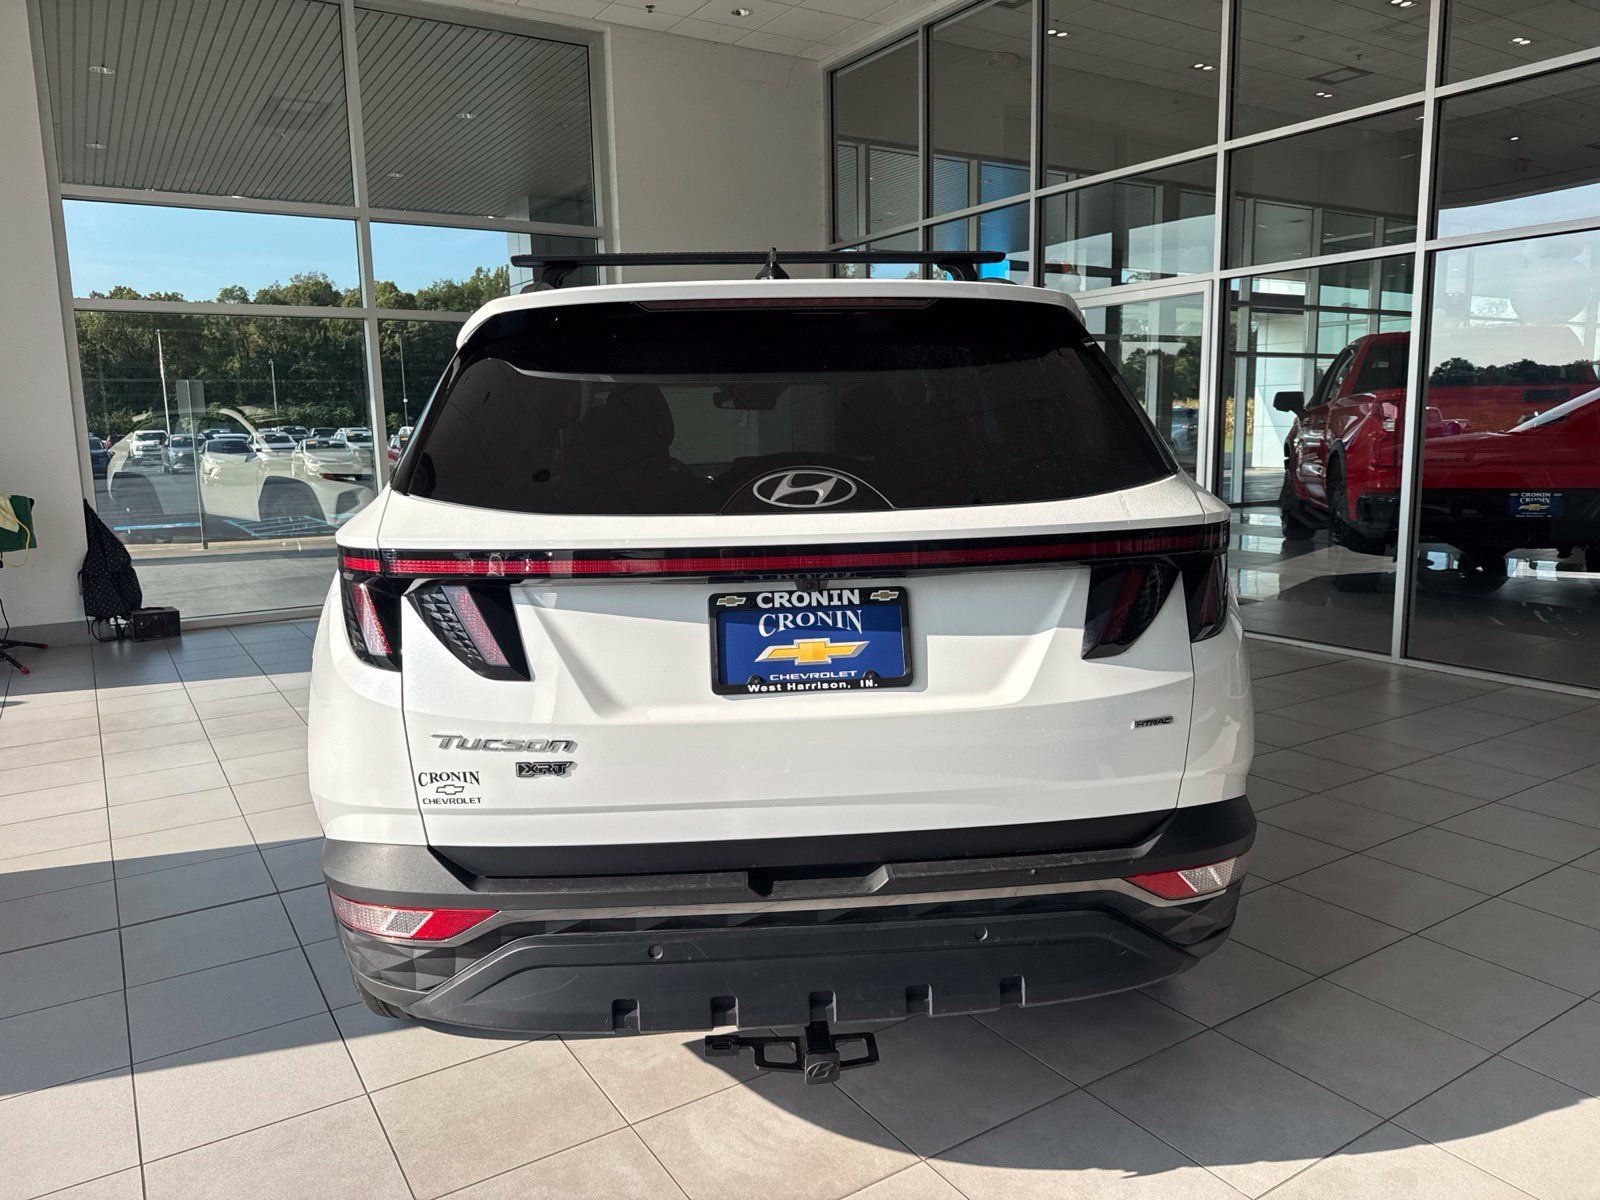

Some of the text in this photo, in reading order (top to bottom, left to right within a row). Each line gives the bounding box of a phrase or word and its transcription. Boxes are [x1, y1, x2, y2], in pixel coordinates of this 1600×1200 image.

[756, 589, 860, 608] CRONIN
[758, 610, 862, 637] CRONIN
[770, 670, 858, 681] CHEVROLET
[748, 679, 878, 692] West Harrison, IN.
[418, 770, 481, 787] CRONIN
[422, 796, 482, 805] CHEVROLET
